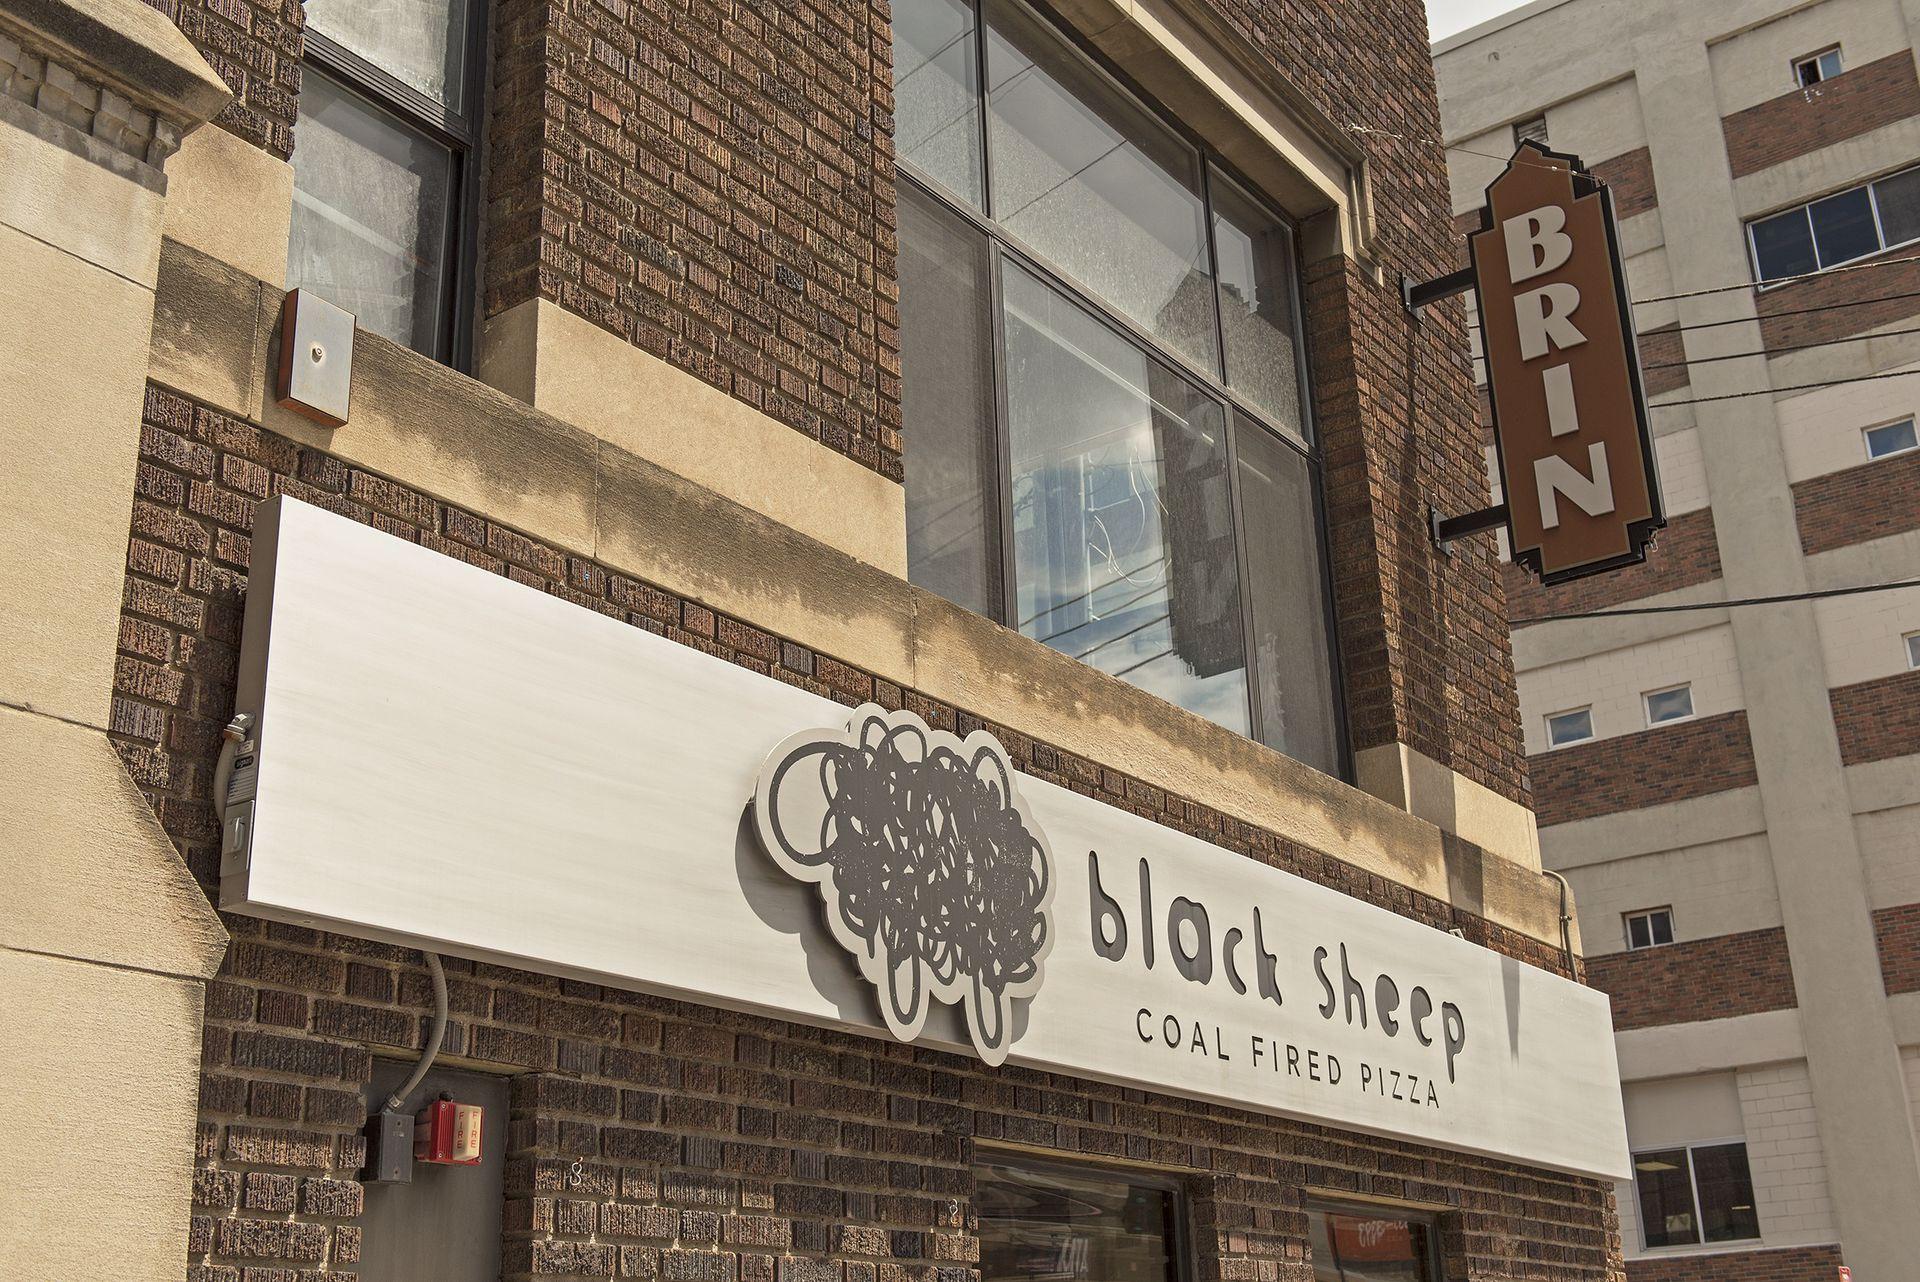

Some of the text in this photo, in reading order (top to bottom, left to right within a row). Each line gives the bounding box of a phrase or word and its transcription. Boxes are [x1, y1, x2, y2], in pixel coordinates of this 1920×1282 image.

[1502, 204, 1616, 530] BRIN
[1088, 849, 1466, 1085] black sheep
[1136, 1007, 1440, 1110] COAL FIRED PIZZA
[456, 1111, 465, 1149] FIRE
[470, 1110, 479, 1149] FIRE
